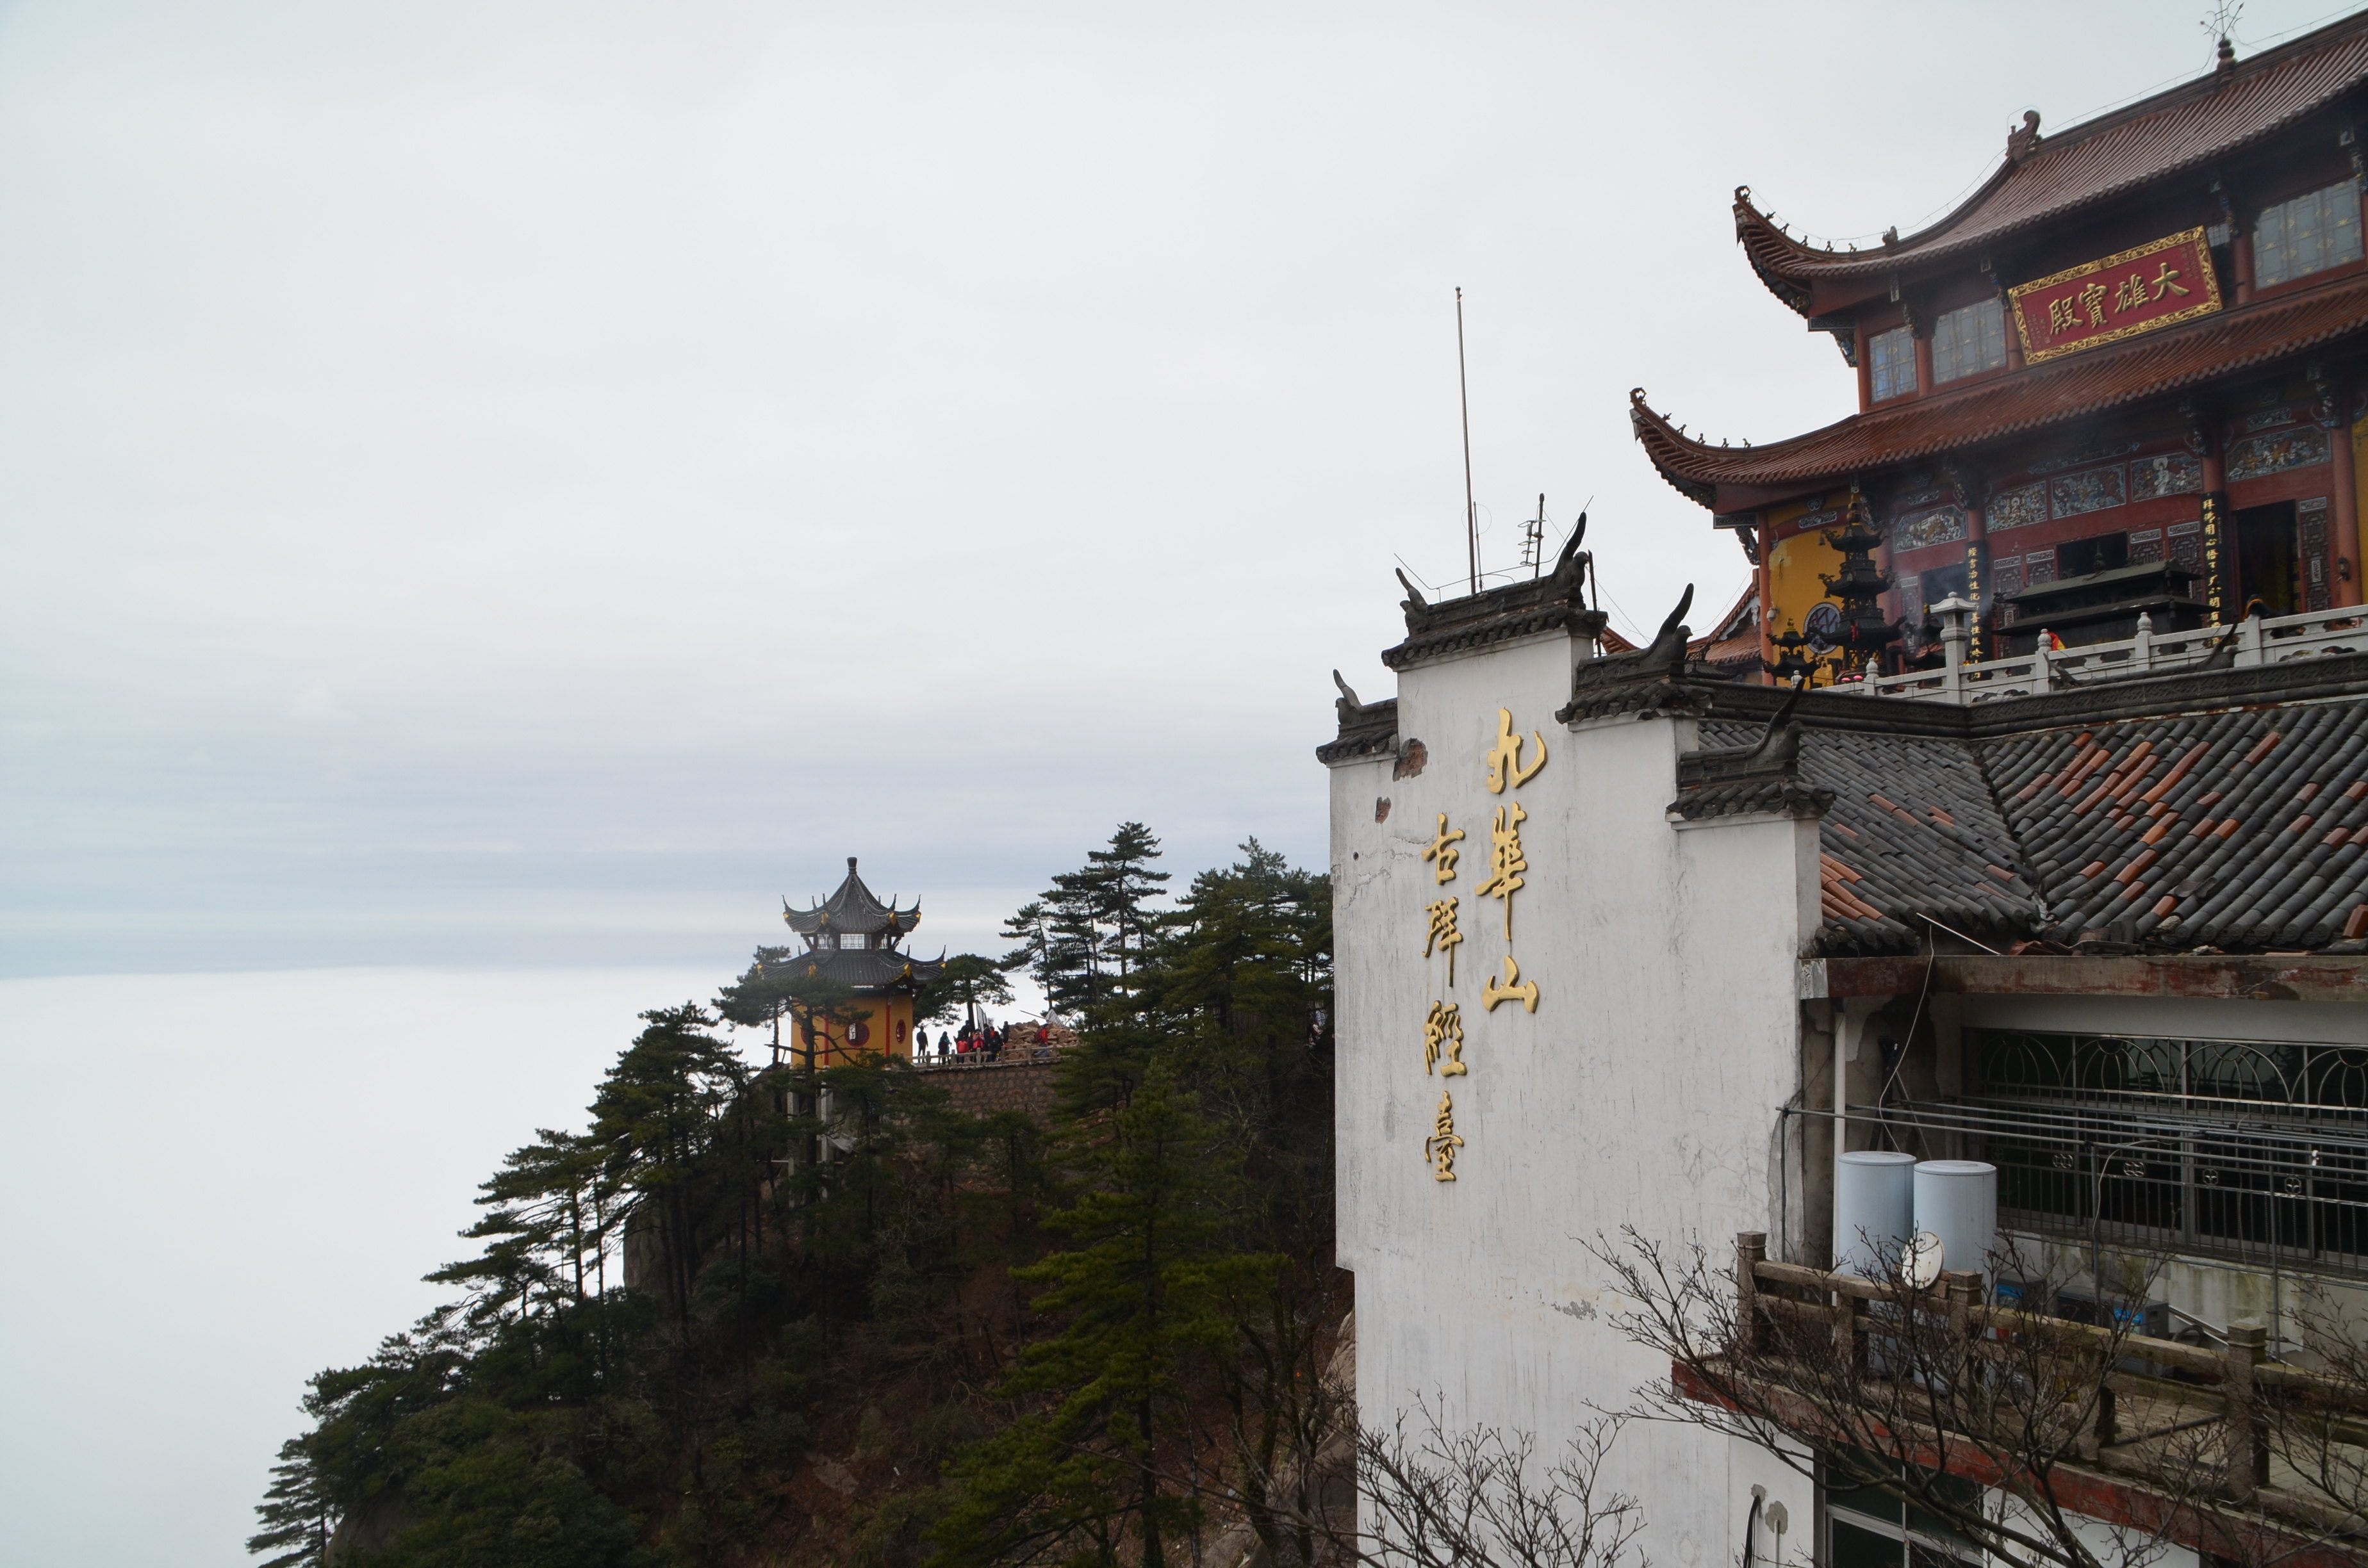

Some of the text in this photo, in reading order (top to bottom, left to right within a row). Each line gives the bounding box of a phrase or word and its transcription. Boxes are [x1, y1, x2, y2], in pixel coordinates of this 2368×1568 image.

[2048, 261, 2191, 336] 大雄寶殿
[1421, 812, 1468, 1182] 古拜經臺
[1475, 706, 1548, 1014] 九華山
